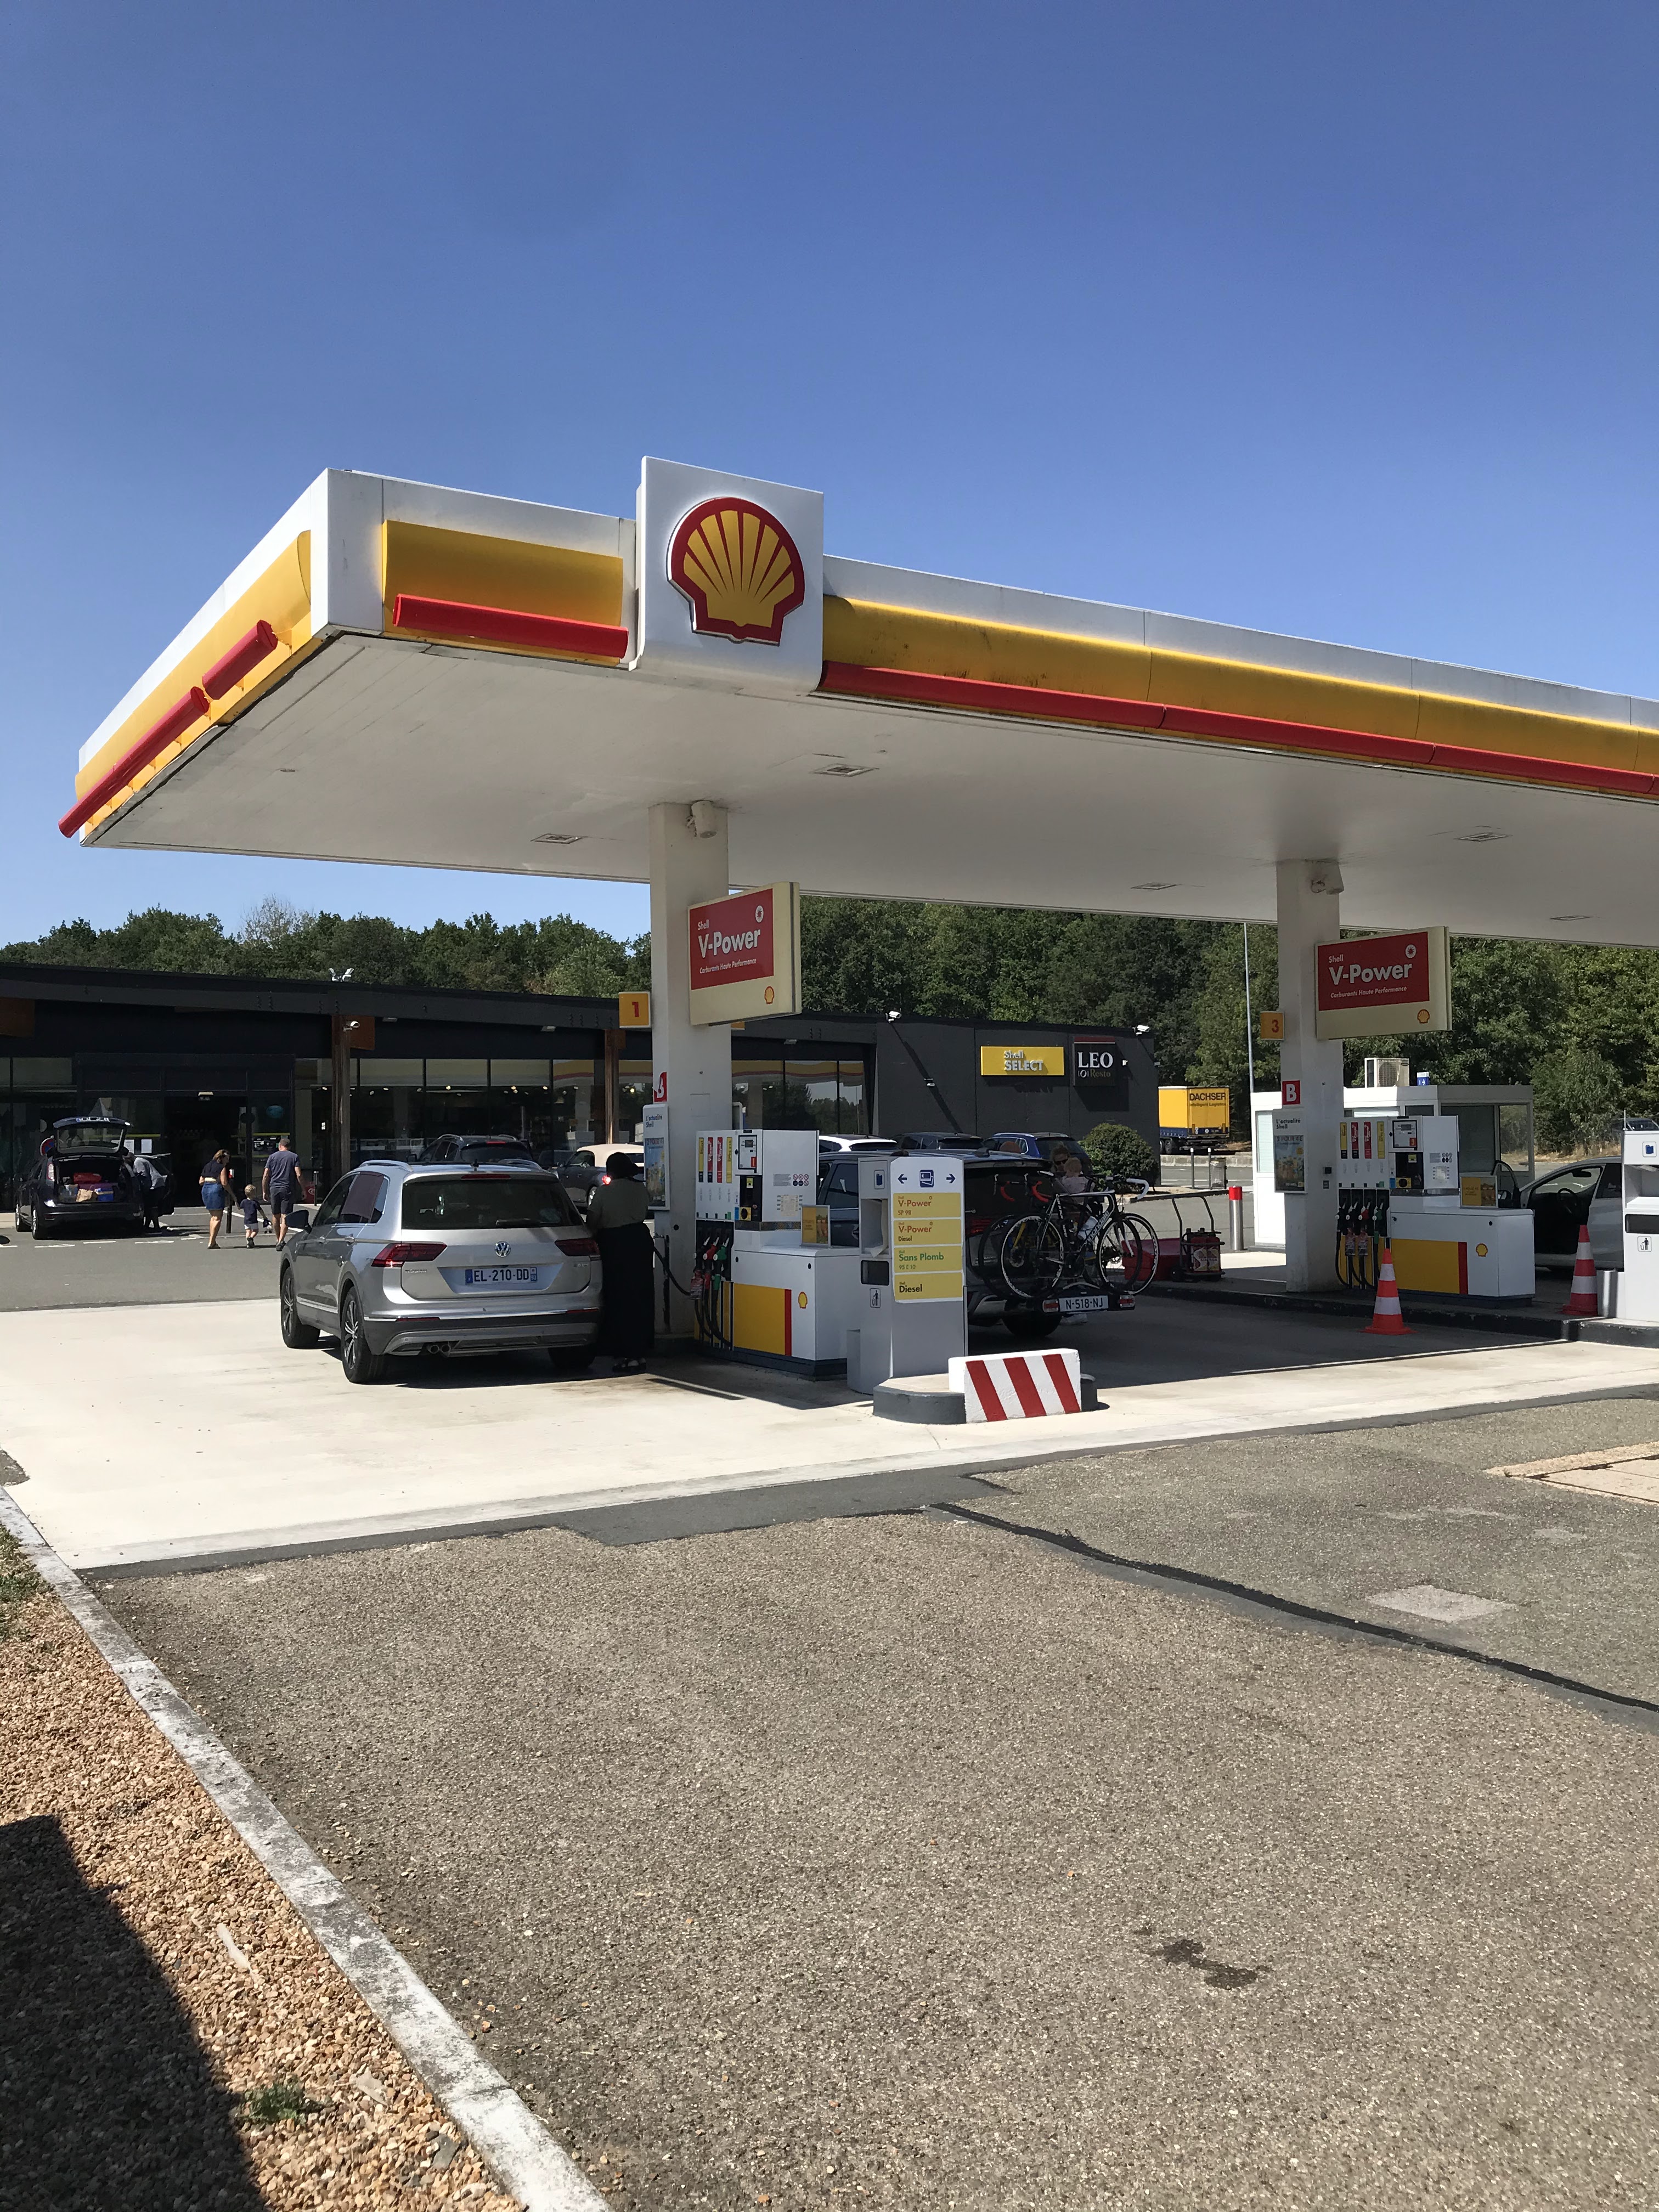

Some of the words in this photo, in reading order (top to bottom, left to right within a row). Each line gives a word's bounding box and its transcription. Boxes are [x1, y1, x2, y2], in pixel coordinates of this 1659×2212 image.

[698, 919, 709, 930] Shell
[698, 929, 760, 958] V-Power
[1329, 955, 1344, 963] Shell
[699, 965, 719, 974] Carburants
[732, 958, 757, 968] Performance
[1329, 963, 1412, 985] V-Power
[631, 1001, 639, 1018] 1
[1271, 1019, 1279, 1033] 3
[1004, 1049, 1024, 1059] Shell
[1077, 1052, 1114, 1068] LEO
[1004, 1060, 1043, 1071] SELECT
[1090, 1069, 1111, 1077] Resto
[1189, 1092, 1226, 1101] DACHSER
[1286, 1084, 1297, 1102] B
[898, 1225, 932, 1233] V-Power
[899, 1254, 918, 1262] Sans
[919, 1252, 944, 1261] Plomb
[473, 1269, 529, 1282] EL-210-DD
[899, 1284, 922, 1293] Diesel
[1065, 1297, 1103, 1310] N-518-NJ
